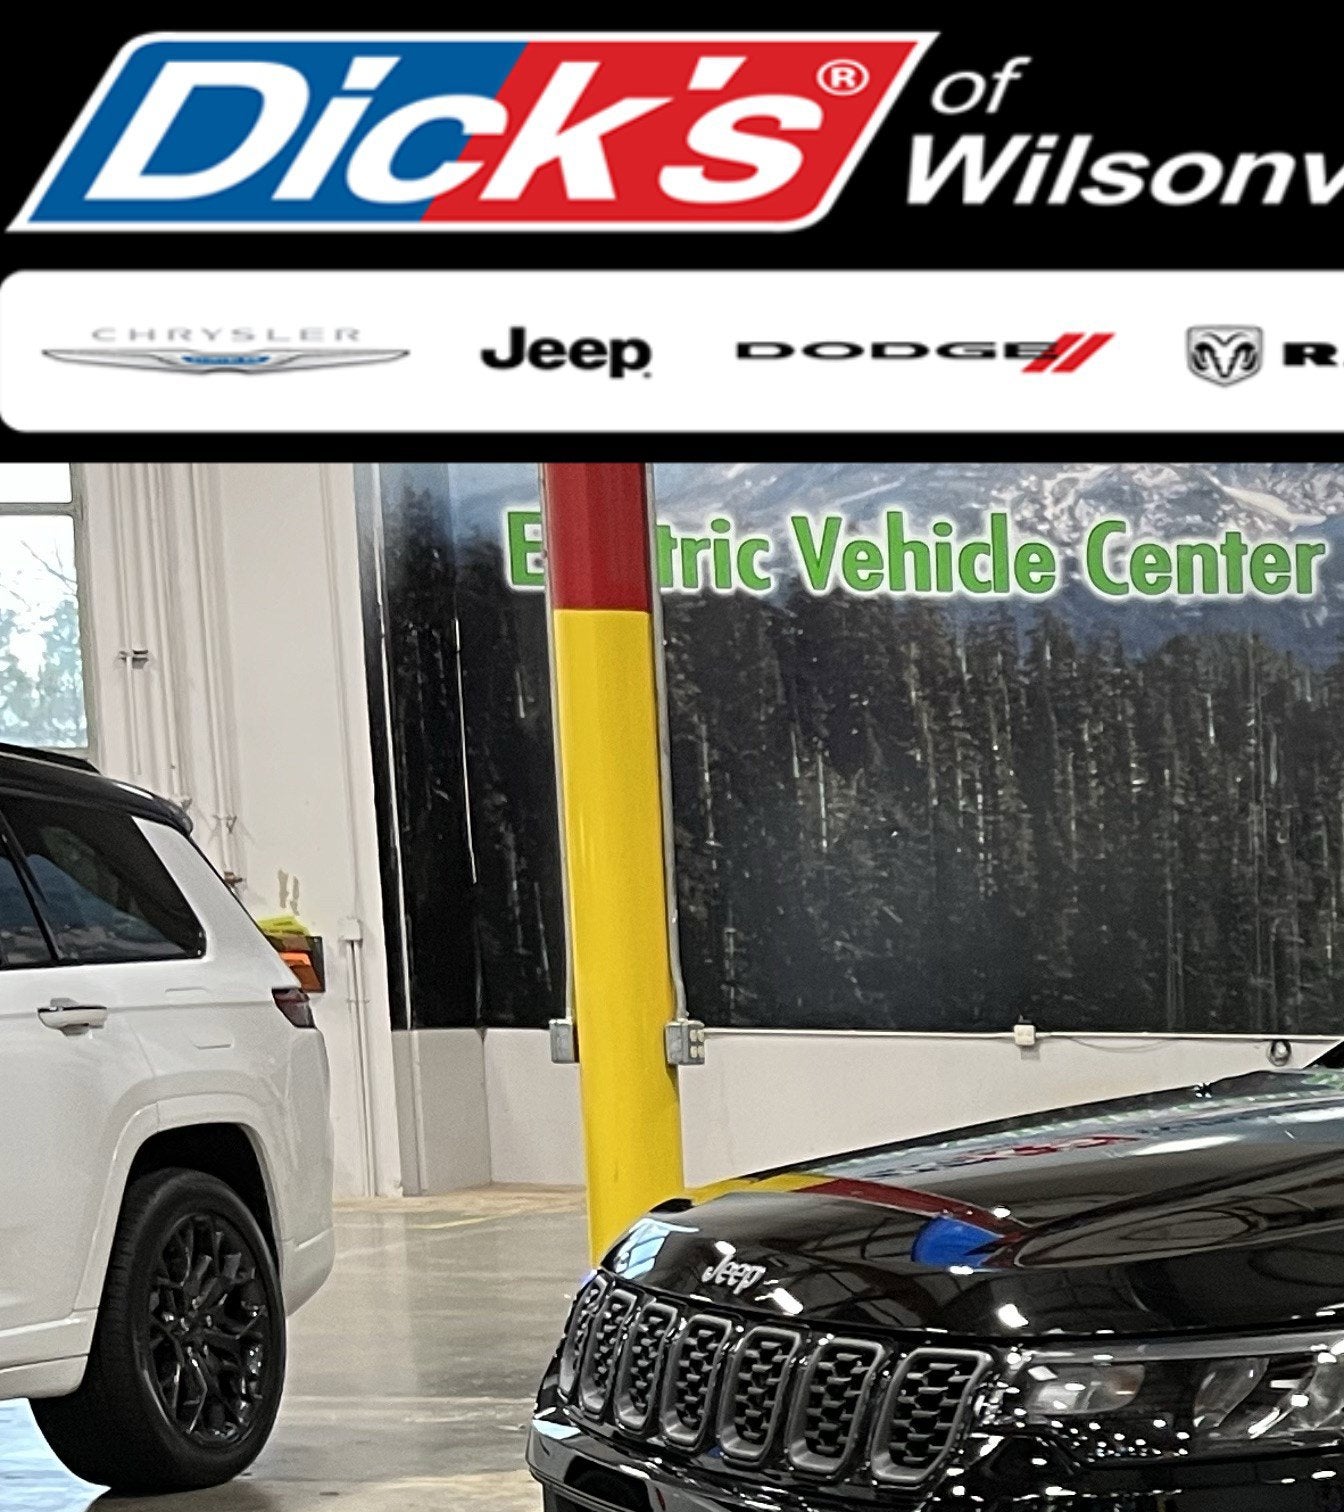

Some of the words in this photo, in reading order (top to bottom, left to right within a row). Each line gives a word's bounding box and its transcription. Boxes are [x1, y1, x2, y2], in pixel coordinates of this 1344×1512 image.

[507, 511, 771, 591] Etric
[793, 510, 1056, 594] Vehicle
[1086, 518, 1326, 596] Center
[701, 1252, 767, 1295] Jeep
